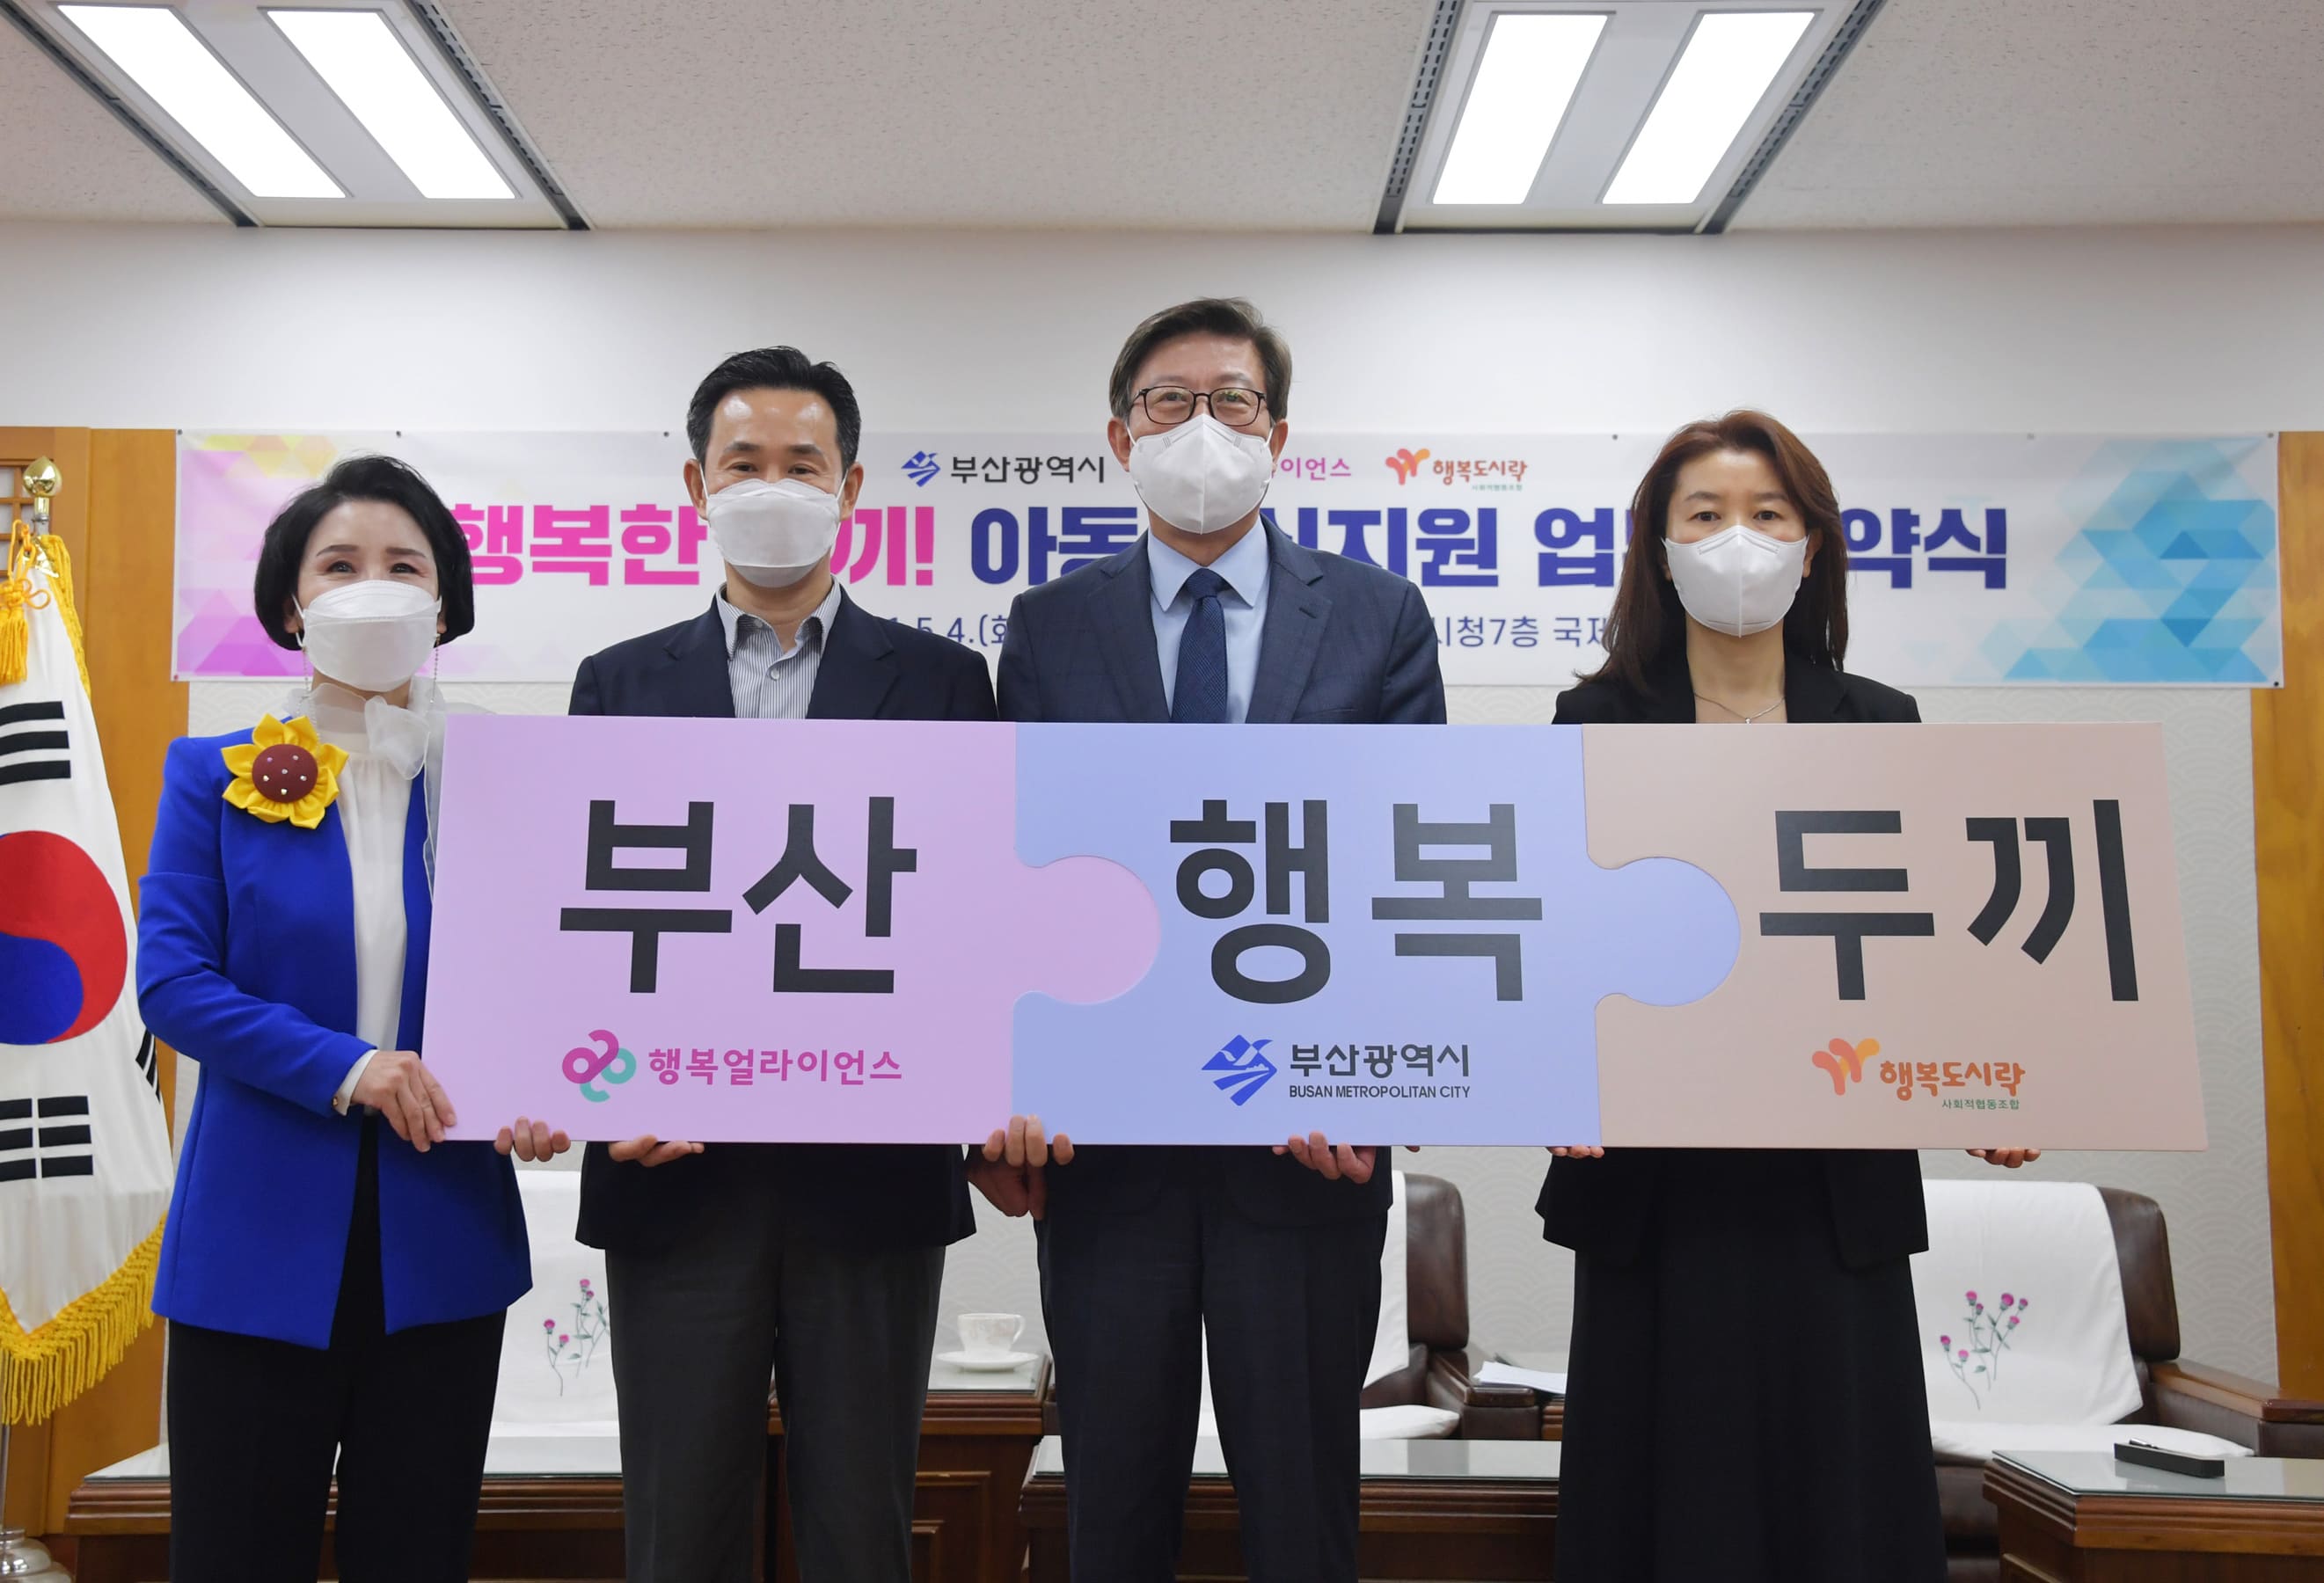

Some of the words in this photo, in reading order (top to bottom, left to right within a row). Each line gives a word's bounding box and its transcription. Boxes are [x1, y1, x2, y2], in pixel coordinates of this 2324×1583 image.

[951, 456, 1105, 485] 부산광역시
[1272, 457, 1352, 481] 이언스
[1432, 459, 1528, 485] 행복도시락
[450, 503, 708, 586] 행복한
[829, 506, 934, 586] 끼!
[1534, 507, 1633, 587] 업
[1840, 507, 2006, 589] 약식
[559, 796, 917, 994] 부산
[1170, 799, 1543, 1004] 행복
[1759, 799, 2139, 1003] 두끼
[648, 1048, 903, 1085] 행복얼라이언스
[1290, 1044, 1469, 1079] 부산광역시
[1290, 1085, 1333, 1098] BUSAN
[1335, 1085, 1436, 1098] METROPOLITAN
[1440, 1085, 1471, 1098] CITY
[1880, 1061, 2026, 1101] 행복도시락
[1941, 1098, 2021, 1110] 사회적협동조합
